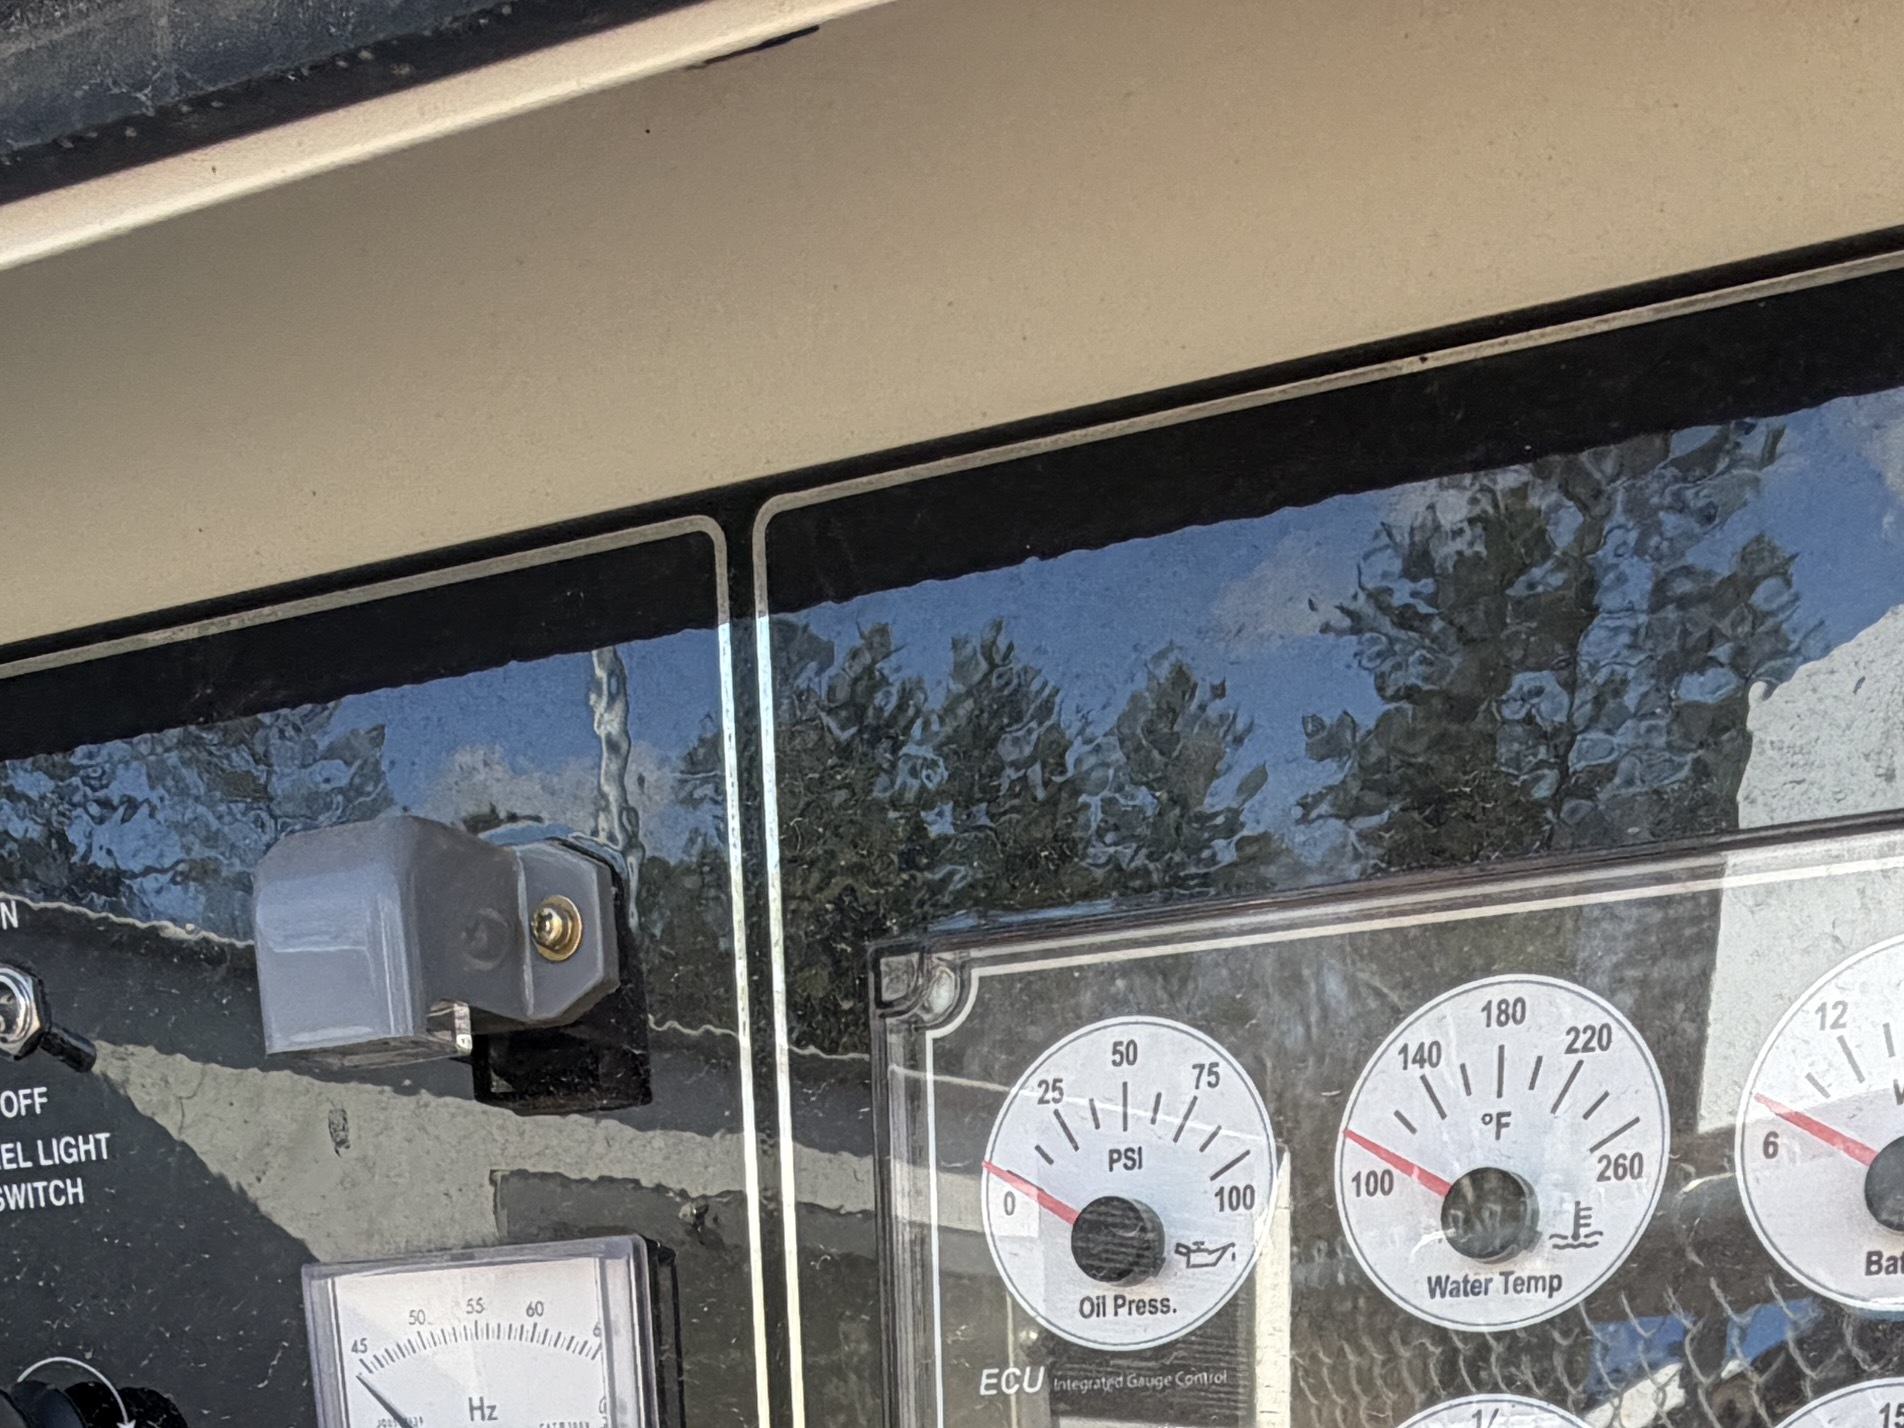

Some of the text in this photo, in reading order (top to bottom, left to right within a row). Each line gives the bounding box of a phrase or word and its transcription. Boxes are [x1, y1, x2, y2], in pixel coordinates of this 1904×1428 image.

[1481, 997, 1526, 1028] 180
[1815, 1000, 1848, 1030] 12
[1565, 1022, 1612, 1054] 220
[1111, 1039, 1138, 1066] 50
[1398, 1040, 1442, 1070] 140
[1192, 1062, 1220, 1089] 75
[0, 1087, 48, 1117] OFF
[1037, 1078, 1064, 1105] 25
[37, 1133, 111, 1166] LIGHT
[1762, 1131, 1779, 1159] 6
[1108, 1147, 1143, 1172] PSI
[1597, 1152, 1644, 1182] 260
[1351, 1169, 1394, 1198] 100
[1004, 1191, 1015, 1216] 0
[1215, 1184, 1255, 1212] 100
[1428, 1271, 1562, 1299] Water Temp
[408, 1310, 426, 1325] 50
[466, 1298, 484, 1314] 55
[526, 1301, 544, 1317] 60
[1079, 1294, 1177, 1318] Oil Press.
[351, 1338, 368, 1353] 45
[980, 1366, 1227, 1396] ECU Integrated Gauge Control
[468, 1396, 498, 1422] Hz
